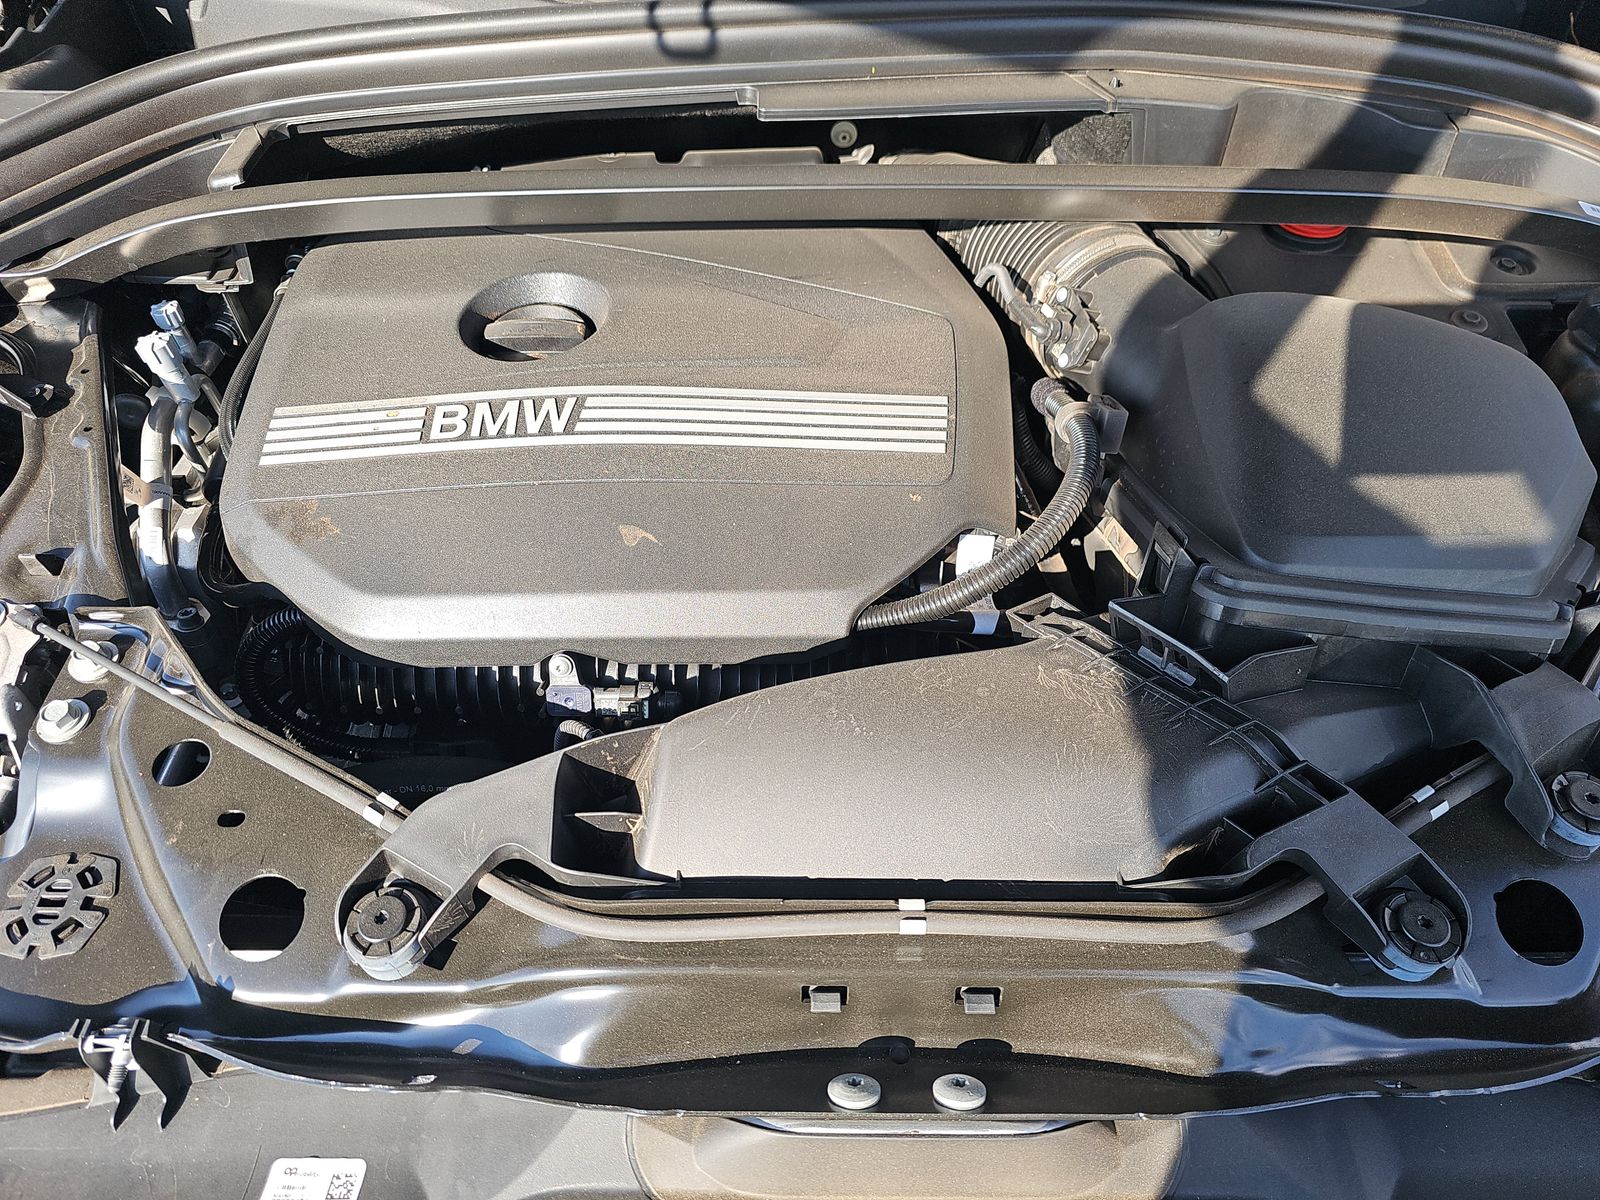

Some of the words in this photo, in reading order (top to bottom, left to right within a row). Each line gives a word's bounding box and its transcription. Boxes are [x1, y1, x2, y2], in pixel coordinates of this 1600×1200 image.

[429, 397, 579, 440] BMW
[399, 785, 414, 794] DN
[416, 784, 434, 793] 16,0
